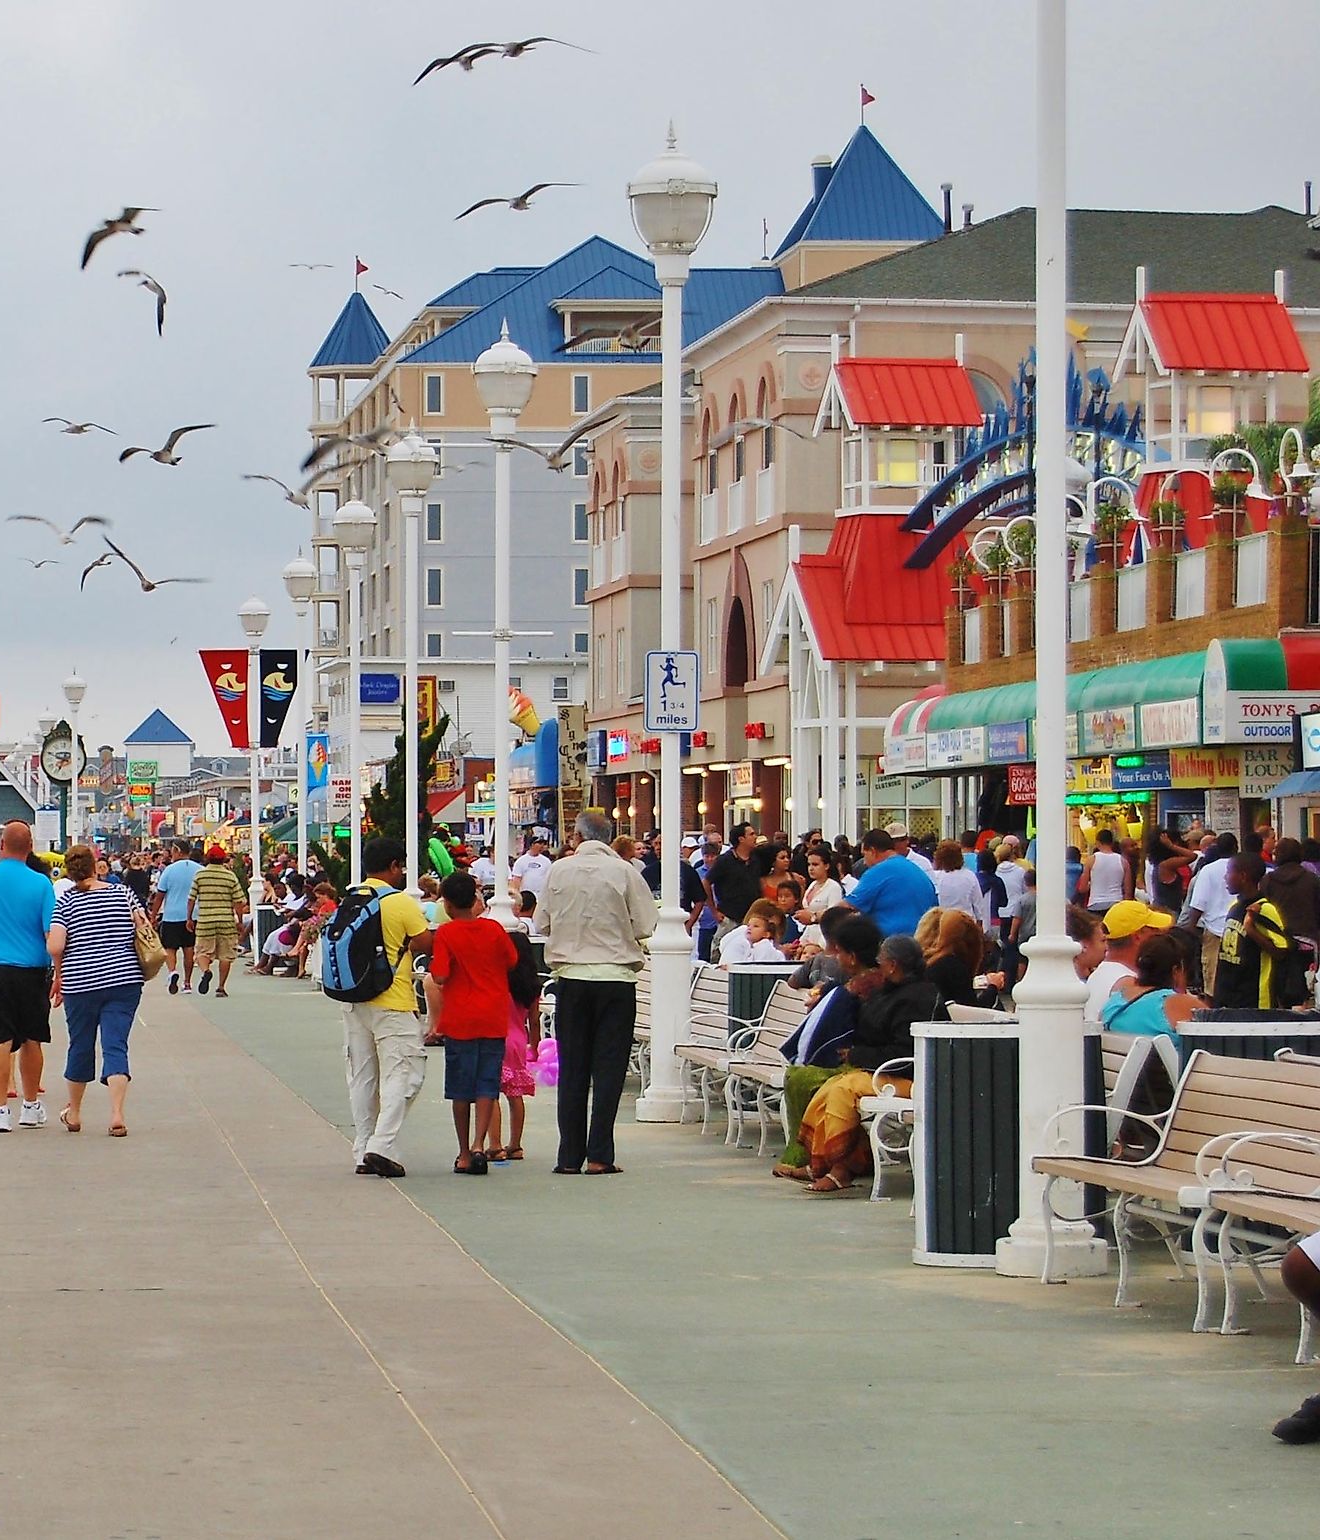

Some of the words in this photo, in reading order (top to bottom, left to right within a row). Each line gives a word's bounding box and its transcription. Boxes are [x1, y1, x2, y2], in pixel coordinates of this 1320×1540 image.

[661, 700, 667, 712] 1
[1242, 704, 1296, 717] TONY'S
[656, 714, 688, 725] miles
[1244, 726, 1292, 737] OUTDOOR
[1244, 751, 1278, 762] BAR
[1171, 751, 1215, 785] Nothing
[1135, 771, 1151, 782] Face
[1152, 770, 1162, 781] On
